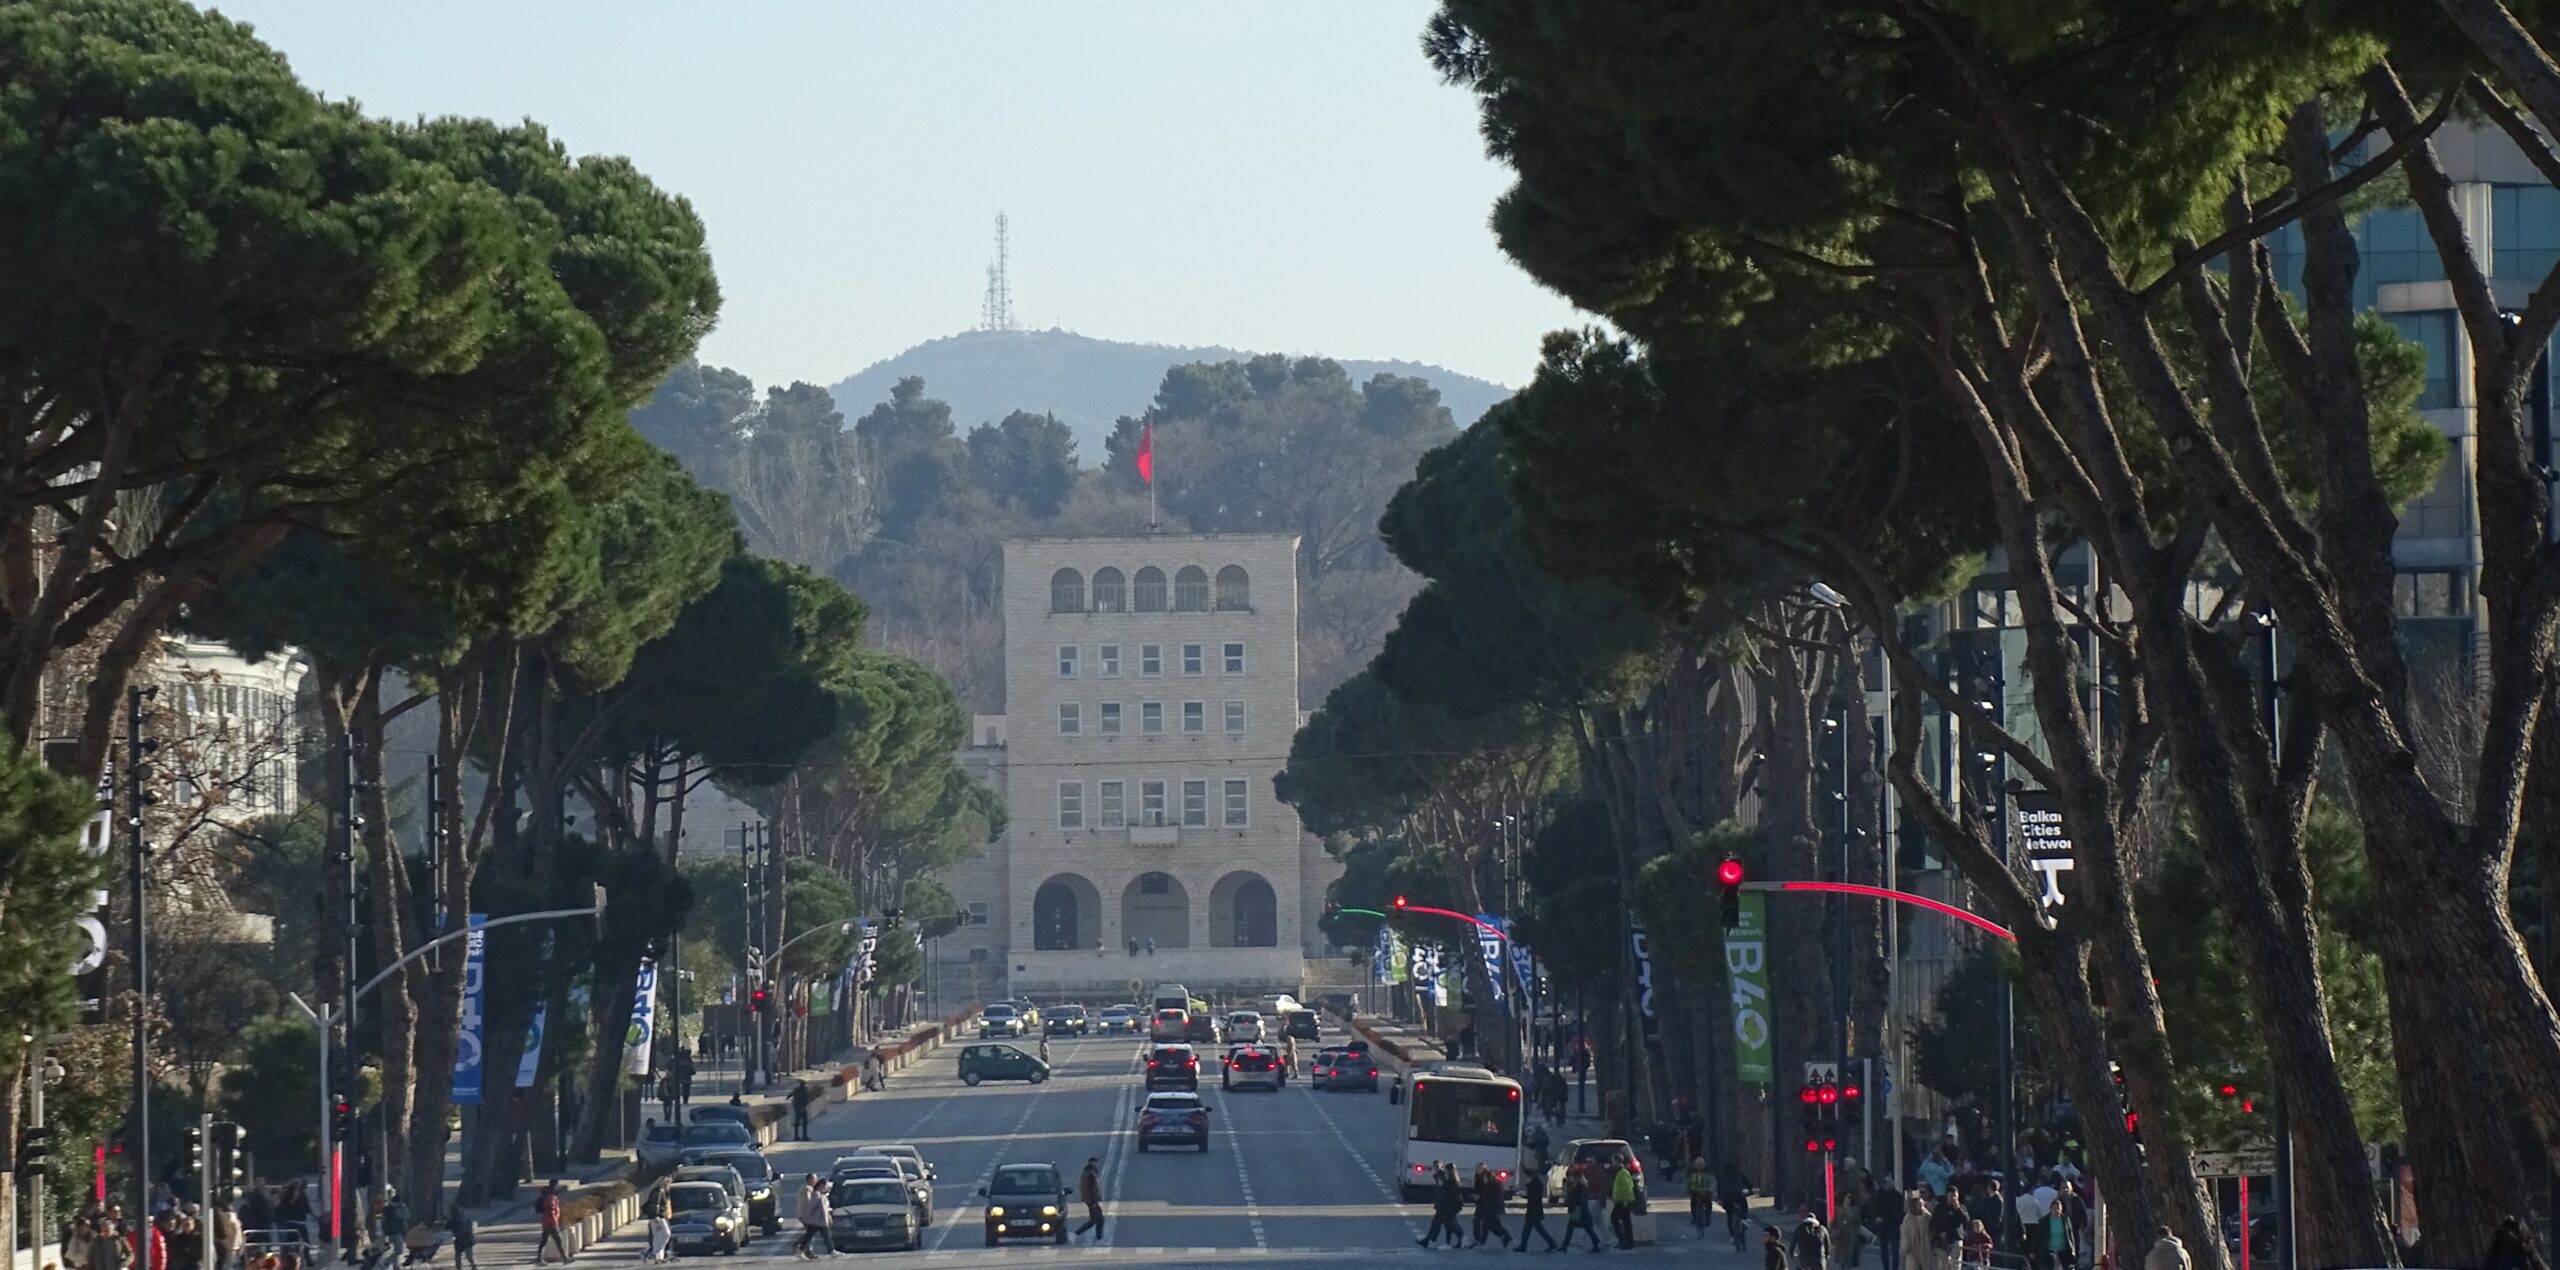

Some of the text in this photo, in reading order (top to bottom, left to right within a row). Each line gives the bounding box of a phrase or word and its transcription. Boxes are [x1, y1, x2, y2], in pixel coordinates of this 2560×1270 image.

[2021, 823, 2062, 836] Cities
[2026, 837, 2072, 850] etwo
[1725, 941, 1768, 1050] B40
